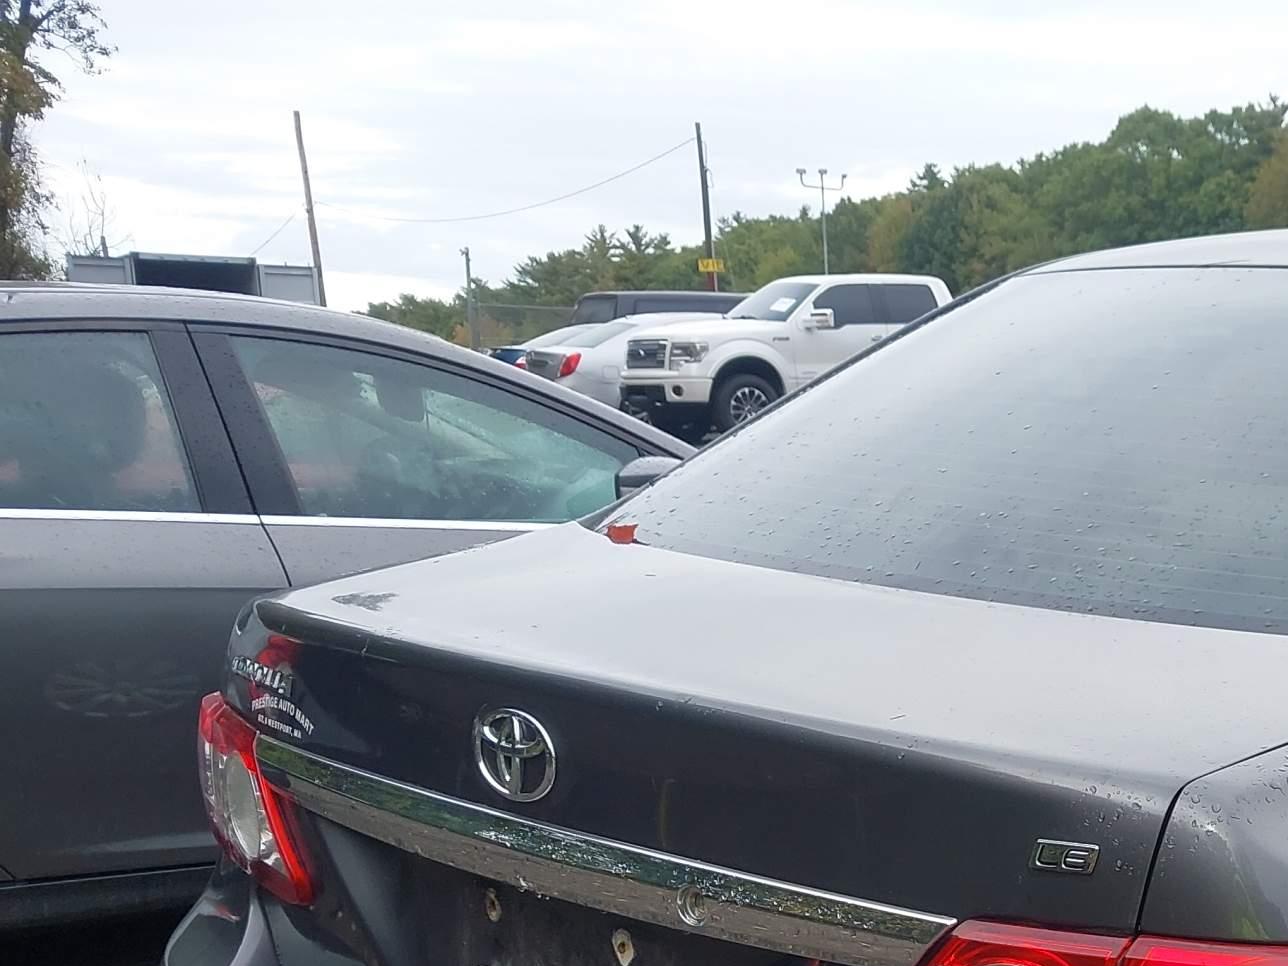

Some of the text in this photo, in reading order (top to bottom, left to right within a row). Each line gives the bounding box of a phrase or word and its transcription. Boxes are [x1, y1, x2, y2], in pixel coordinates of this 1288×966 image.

[251, 694, 315, 736] PRESTIGE AUTO MART
[1034, 838, 1100, 874] LE
